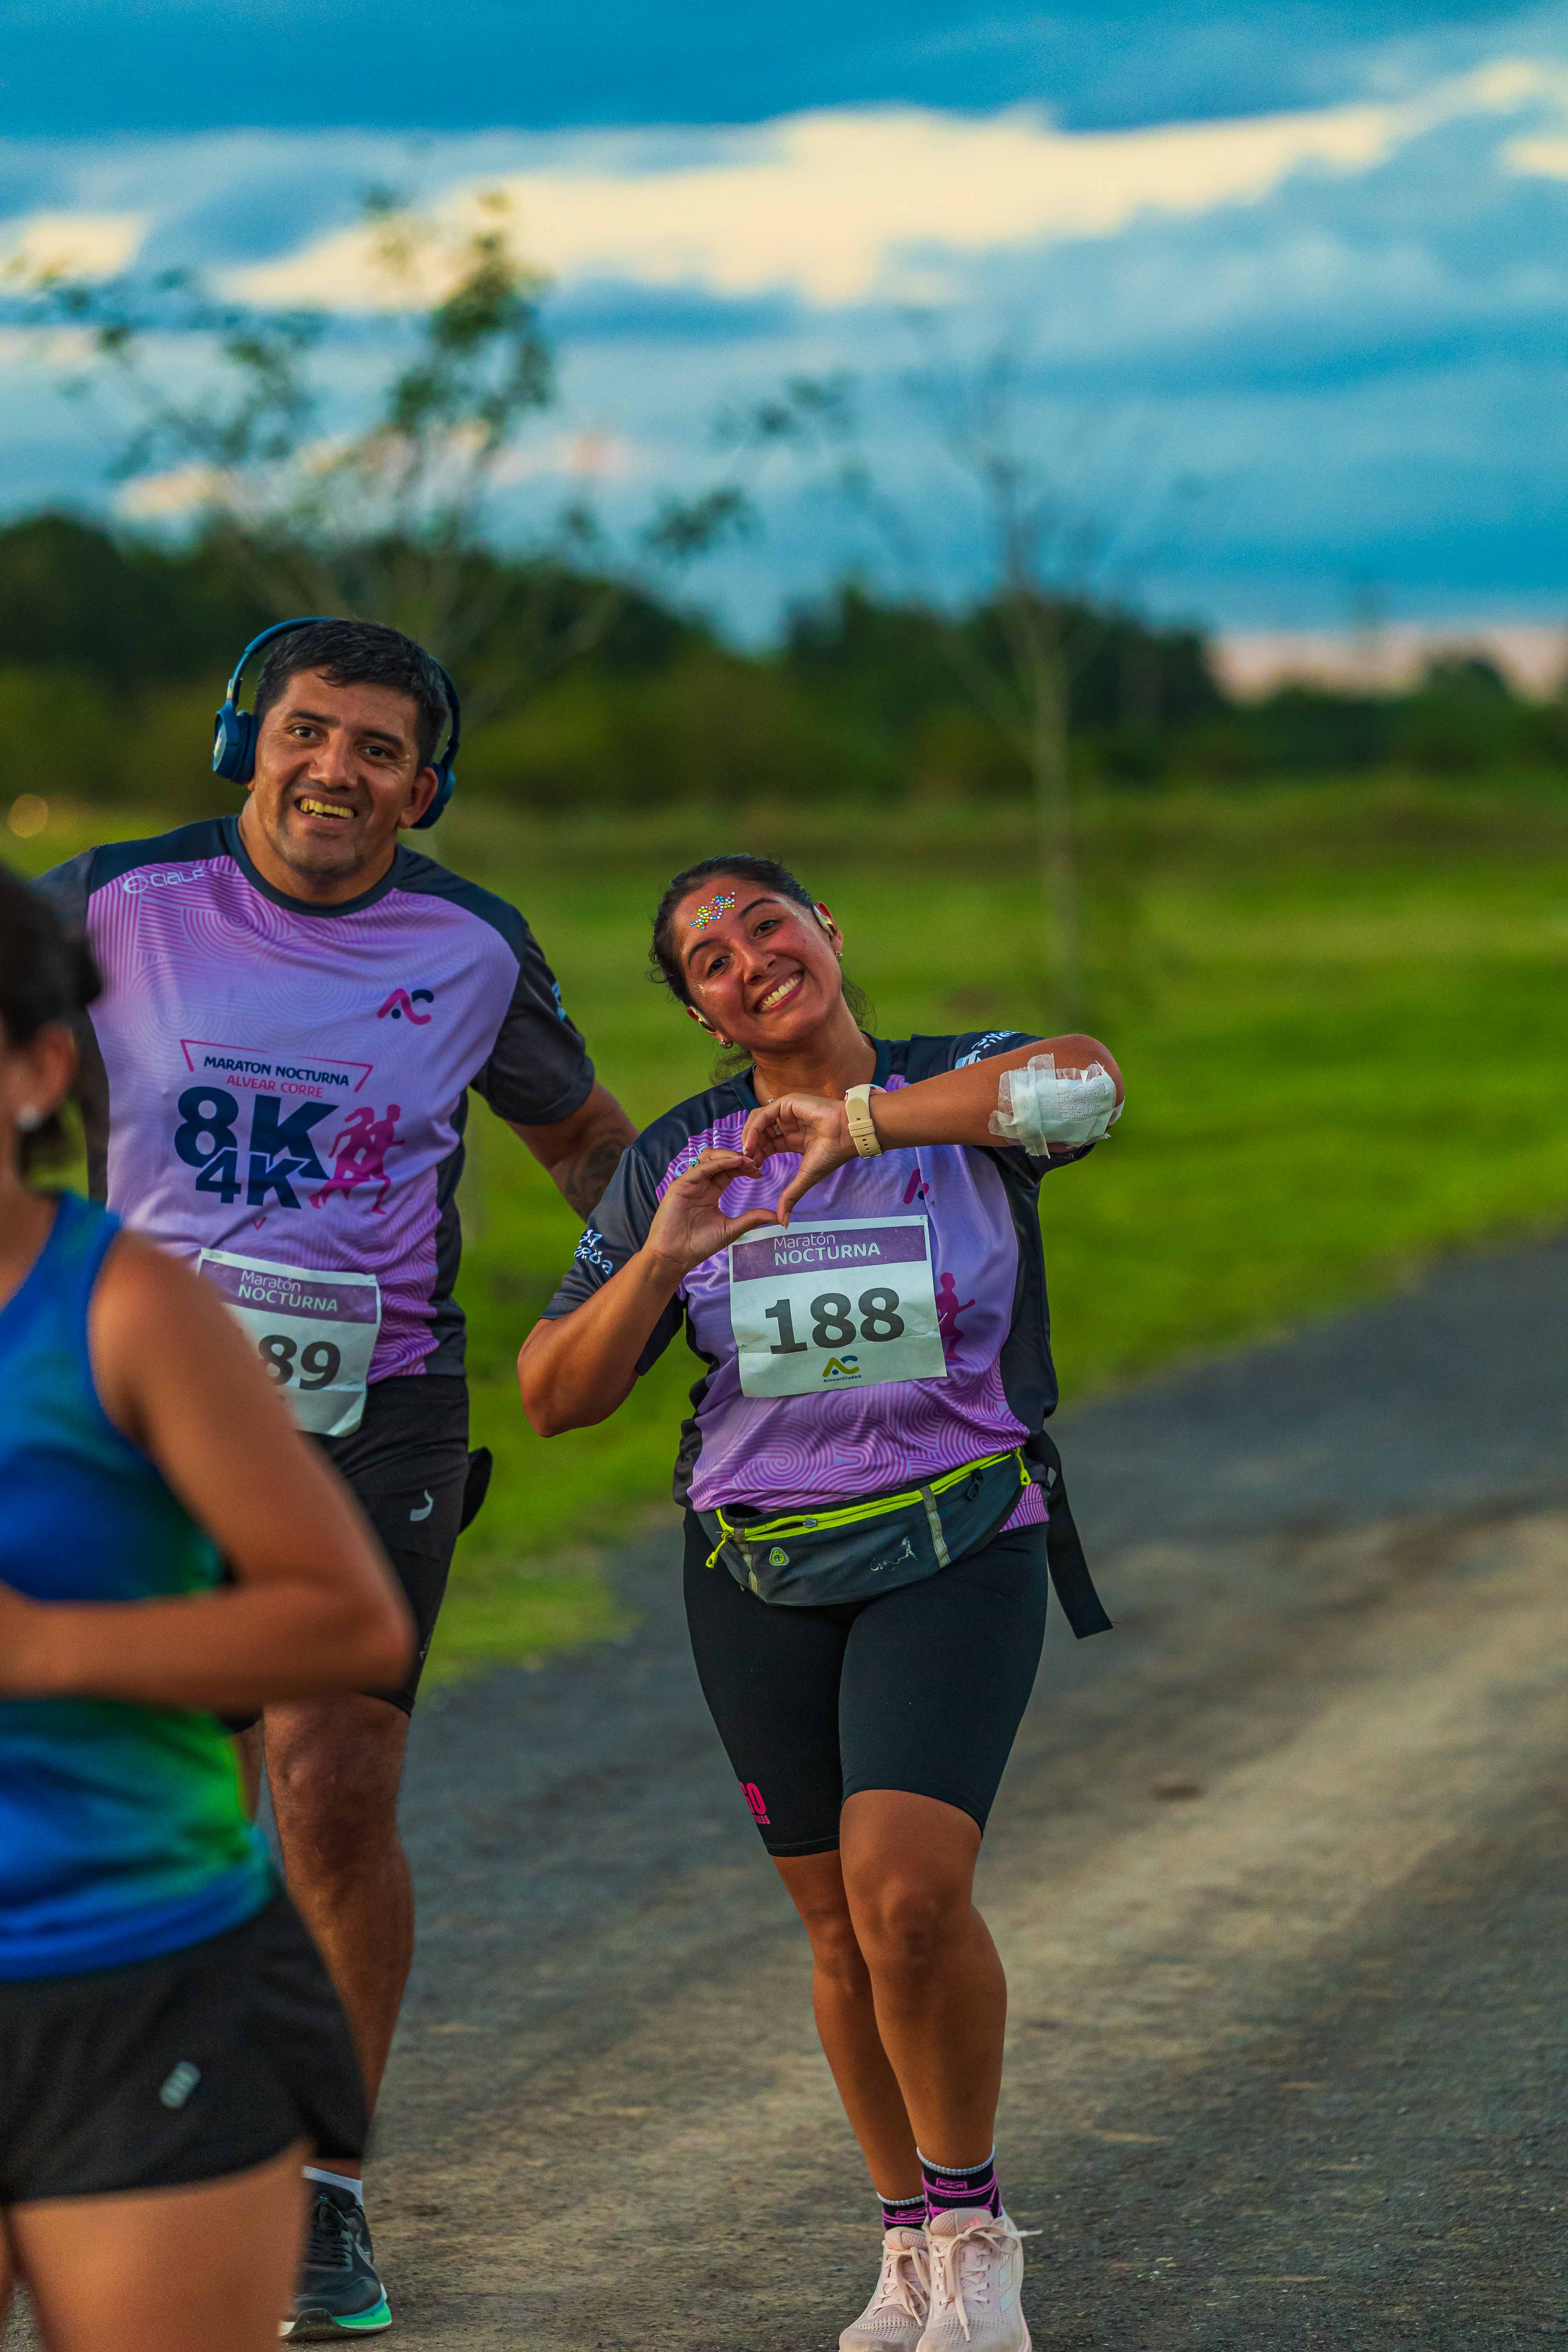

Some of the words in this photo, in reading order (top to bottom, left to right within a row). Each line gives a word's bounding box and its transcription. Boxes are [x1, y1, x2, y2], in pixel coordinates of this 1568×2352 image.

[204, 1056, 271, 1075] MARATON
[275, 1066, 349, 1086] NOCTURNA
[226, 1075, 276, 1092] ALVEAR
[280, 1082, 324, 1098] CORRE
[174, 1086, 339, 1180] 8K
[195, 1150, 302, 1210] 4K
[774, 1232, 835, 1250] Maratón
[774, 1242, 881, 1266] NOCTURNA
[241, 1270, 301, 1292] Maratón
[238, 1284, 338, 1312] NOCTURNA
[765, 1287, 905, 1354] 188
[258, 1334, 341, 1391] 89
